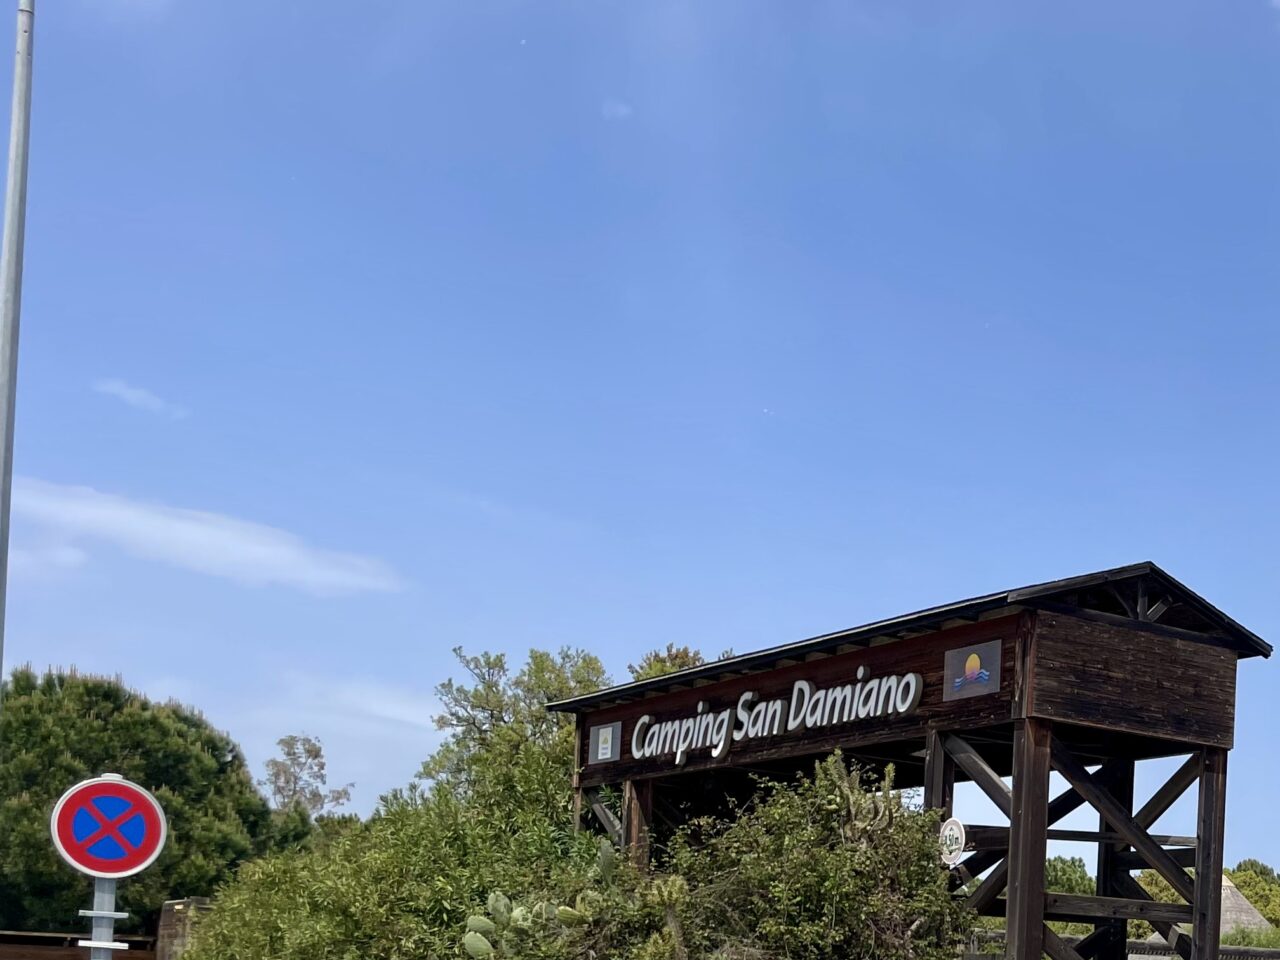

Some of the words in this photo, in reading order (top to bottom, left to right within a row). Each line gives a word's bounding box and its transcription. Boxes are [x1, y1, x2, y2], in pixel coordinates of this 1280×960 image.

[631, 701, 733, 765] Camping
[733, 691, 784, 742] San
[787, 665, 918, 732] Damiano
